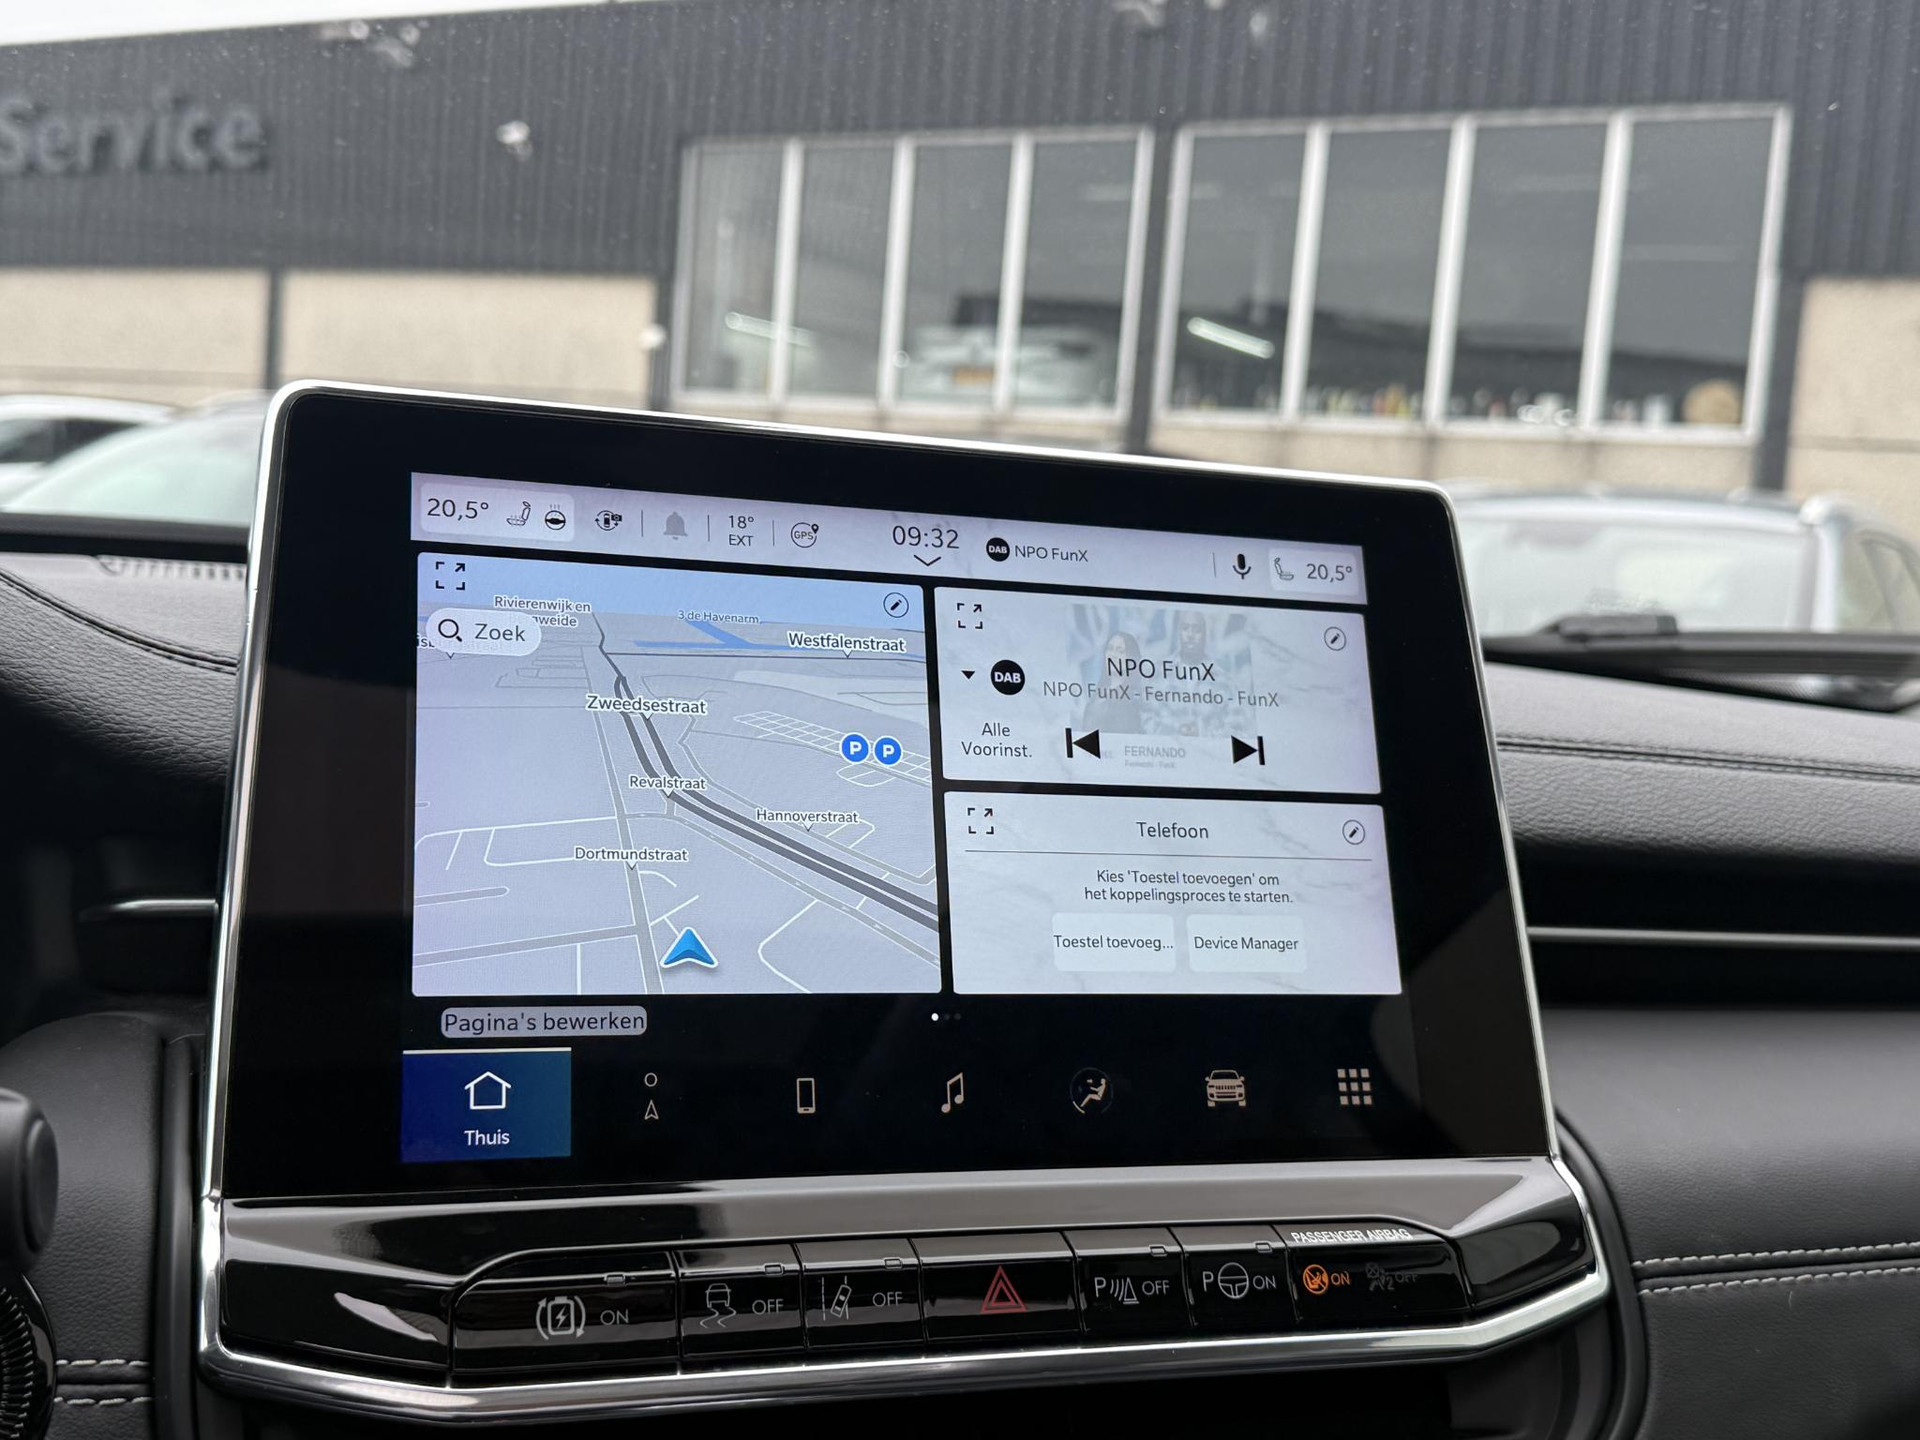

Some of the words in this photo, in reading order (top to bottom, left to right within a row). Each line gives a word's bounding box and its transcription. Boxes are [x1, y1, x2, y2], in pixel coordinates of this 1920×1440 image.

[0, 87, 264, 173] Service
[728, 514, 755, 530] 18°
[728, 533, 754, 547] EXT
[793, 529, 814, 541] GPS
[892, 524, 960, 550] 09:32
[988, 544, 1008, 556] DAB
[1014, 544, 1048, 560] NPO
[1051, 547, 1089, 563] FunX
[494, 595, 573, 613] Rivierenwijk
[575, 602, 591, 612] en
[678, 610, 685, 621] 3
[687, 610, 702, 622] de
[474, 622, 526, 643] Zoek
[788, 631, 906, 653] Westfalenstraat
[993, 670, 1022, 685] DAB
[1107, 656, 1156, 680] NPO
[1162, 659, 1216, 683] FunX
[1043, 680, 1083, 699] NPO
[1087, 683, 1132, 702] FunX
[1144, 685, 1224, 706] Fernando
[1237, 690, 1280, 709] FunX
[586, 695, 707, 715] Zweedsestraat
[981, 721, 1011, 737] Alle
[961, 740, 1033, 758] Voorinst.
[1124, 745, 1186, 759] FERNANDO
[629, 775, 707, 790] Revalstraat
[756, 808, 859, 824] Hannoverstraat
[1136, 821, 1210, 839] Telefoon
[574, 846, 689, 862] Dortmundstraat
[1096, 869, 1125, 884] Kies
[1127, 869, 1181, 885] 'Toestel
[1182, 872, 1256, 888] toevoegen'
[1258, 875, 1280, 886] om
[1084, 886, 1107, 901] het
[1109, 887, 1226, 905] koppelingsproces
[1228, 890, 1242, 903] te
[1243, 891, 1294, 904] starten.
[1053, 934, 1104, 949] Toestel
[1106, 936, 1175, 952] toevoeg...
[1194, 935, 1239, 951] Device
[1240, 937, 1300, 953] Manager
[444, 1012, 537, 1036] Pagina's
[543, 1011, 645, 1031] bewerken
[464, 1129, 510, 1146] Thuis
[1290, 1229, 1364, 1244] PASSENGER
[1363, 1228, 1413, 1241] AIRBAG
[1252, 1275, 1276, 1290] ON
[1330, 1271, 1351, 1286] ON
[1141, 1280, 1170, 1295] OFF
[751, 1298, 784, 1315] OFF
[872, 1291, 903, 1308] OFF
[600, 1308, 629, 1326] ON
